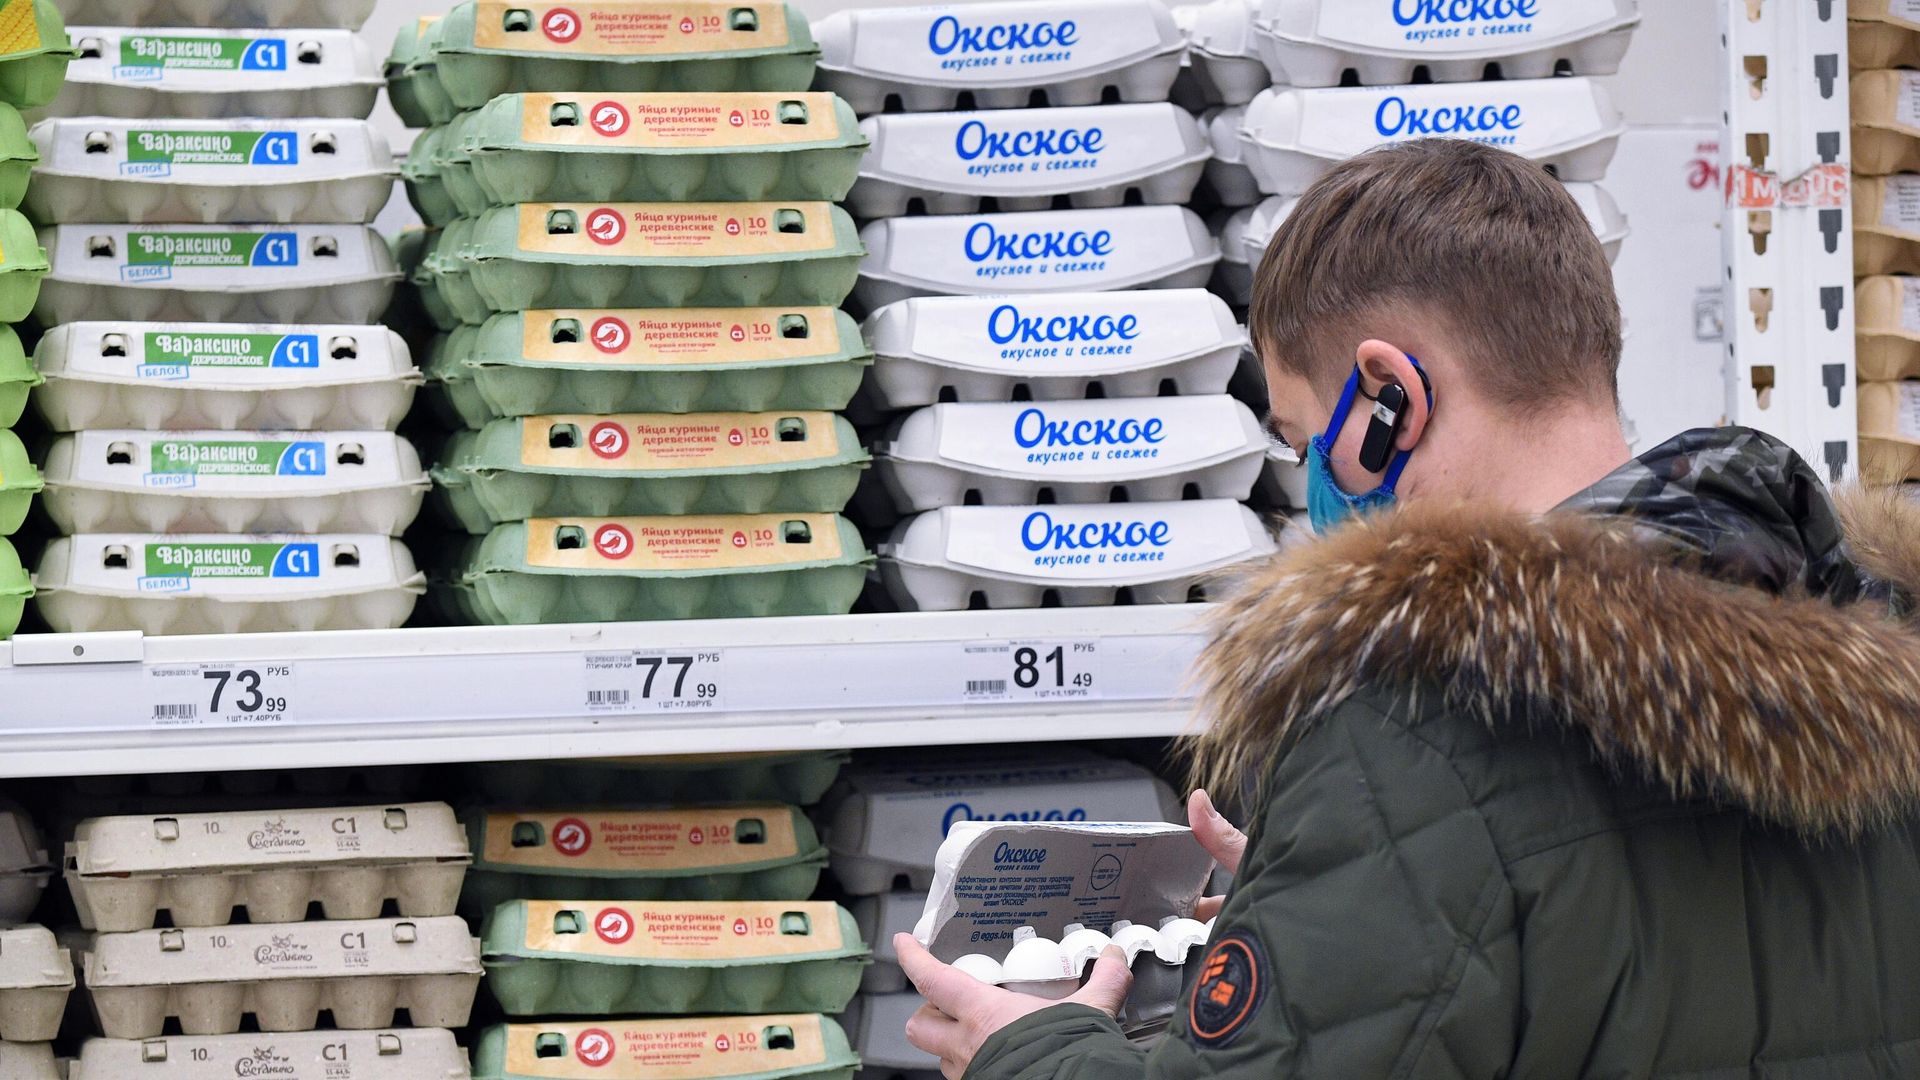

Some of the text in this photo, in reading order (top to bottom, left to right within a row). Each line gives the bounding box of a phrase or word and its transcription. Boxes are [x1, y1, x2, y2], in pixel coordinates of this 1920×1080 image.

[590, 12, 672, 23] Яйца куриные
[1393, 0, 1541, 26] Окское
[595, 22, 668, 31] деревенские
[703, 16, 720, 26] 10
[928, 16, 1079, 55] Окское
[1406, 23, 1533, 43] вкусное и свежее
[131, 38, 222, 59] Вараксино
[256, 45, 278, 67] С1
[942, 51, 1071, 71] вкусное и свежее
[639, 105, 721, 115] Яйца куриные
[752, 110, 769, 120] 10
[1375, 97, 1526, 136] Окское
[644, 115, 717, 124] деревенские
[138, 133, 231, 153] Вараксино
[956, 121, 1107, 160] Окское
[266, 138, 289, 160] С1
[967, 159, 1097, 177] вкусное и свежее
[635, 213, 717, 222] Яйца куриные
[748, 218, 766, 228] 10
[640, 223, 714, 232] деревенские
[138, 235, 231, 256] Вараксино
[965, 222, 1116, 262] Окское
[267, 239, 288, 262] С1
[128, 267, 163, 277] БЕЛОЕ
[976, 261, 1106, 278] вкусное и свежее
[639, 321, 722, 330] Яйца куриные
[753, 324, 770, 334] 10
[988, 305, 1141, 344] Окское
[645, 330, 719, 340] деревенские
[156, 336, 250, 356] Вараксино
[286, 341, 309, 363] С1
[1001, 345, 1132, 361] вкусное и свежее
[145, 367, 181, 376] БЕЛОЕ
[637, 425, 720, 435] Яйца куриные
[751, 427, 768, 438] 10
[1014, 409, 1168, 449] Окское
[643, 435, 717, 445] деревенские
[163, 444, 257, 464] Вараксино
[294, 449, 316, 471] С1
[1027, 449, 1158, 465] вкусное и свежее
[151, 475, 187, 485] БЕЛОЕ
[642, 527, 724, 537] Яйца куриные
[755, 530, 773, 540] 10
[1021, 512, 1173, 551] Окское
[648, 537, 721, 547] деревенские
[156, 547, 251, 567] Вараксино
[287, 551, 310, 572] С1
[1034, 551, 1165, 568] вкусное и свежее
[146, 579, 182, 589] БЕЛОЕ
[1074, 644, 1094, 652] РУБ
[698, 654, 719, 662] РУБ
[267, 667, 289, 676] РУБ
[1014, 646, 1064, 688] 81
[636, 657, 693, 698] 77
[1073, 673, 1091, 686] 49
[204, 669, 263, 713] 73
[697, 683, 716, 697] 99
[266, 697, 286, 712] 99
[204, 822, 220, 834] 10
[332, 818, 356, 834] С1
[712, 826, 730, 837] 10
[994, 842, 1046, 863] Окское
[643, 912, 725, 922] Яйца куриные
[756, 918, 773, 928] 10
[648, 922, 722, 932] деревенские
[210, 936, 226, 948] 10
[341, 933, 366, 949] С1
[624, 1031, 707, 1040] Яйца куриные
[738, 1033, 755, 1044] 10
[322, 1044, 347, 1060] С1
[630, 1041, 704, 1050] деревенские
[190, 1049, 207, 1060] 10
